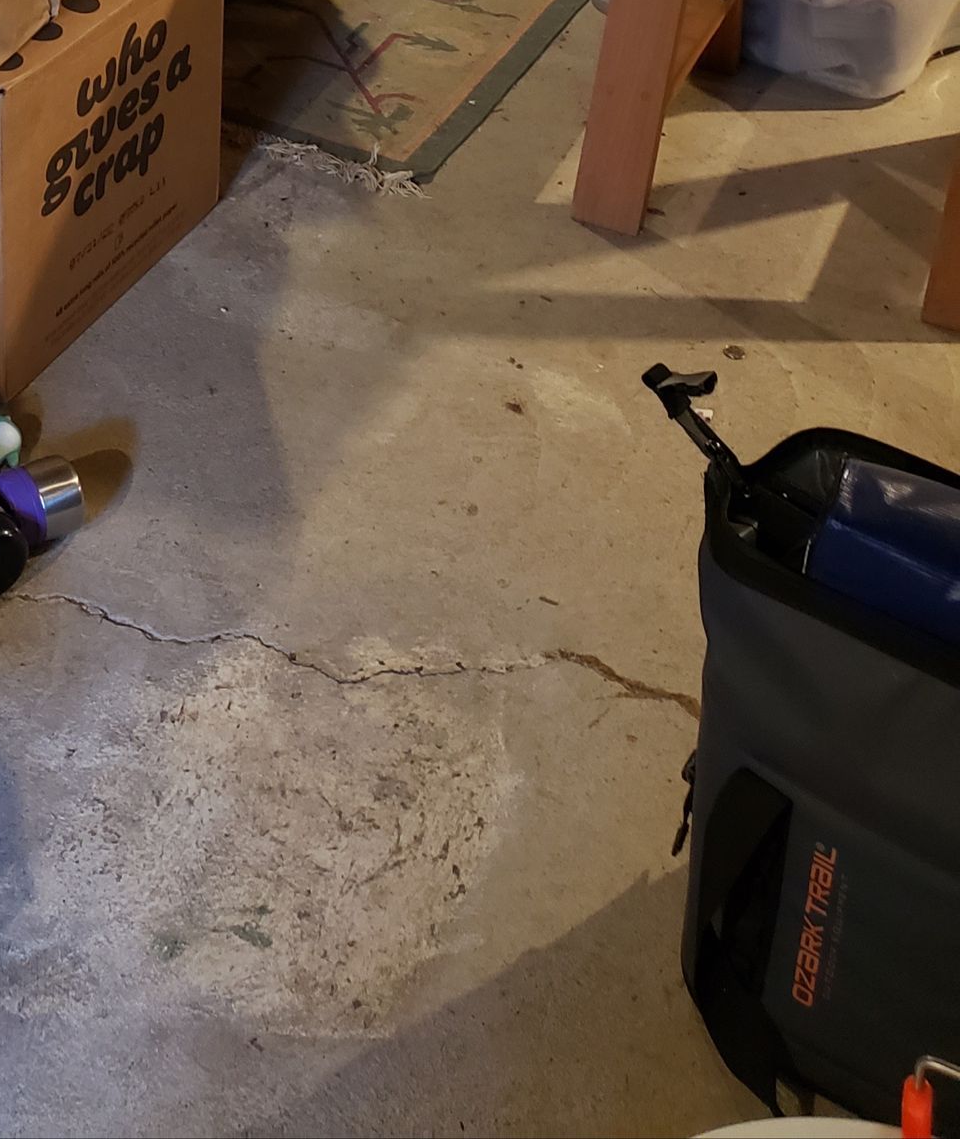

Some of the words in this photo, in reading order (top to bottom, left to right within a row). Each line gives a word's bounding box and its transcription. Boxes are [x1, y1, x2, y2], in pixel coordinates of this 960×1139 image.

[77, 19, 167, 117] who
[41, 69, 160, 217] gives
[166, 44, 192, 92] a
[73, 112, 164, 217] crap
